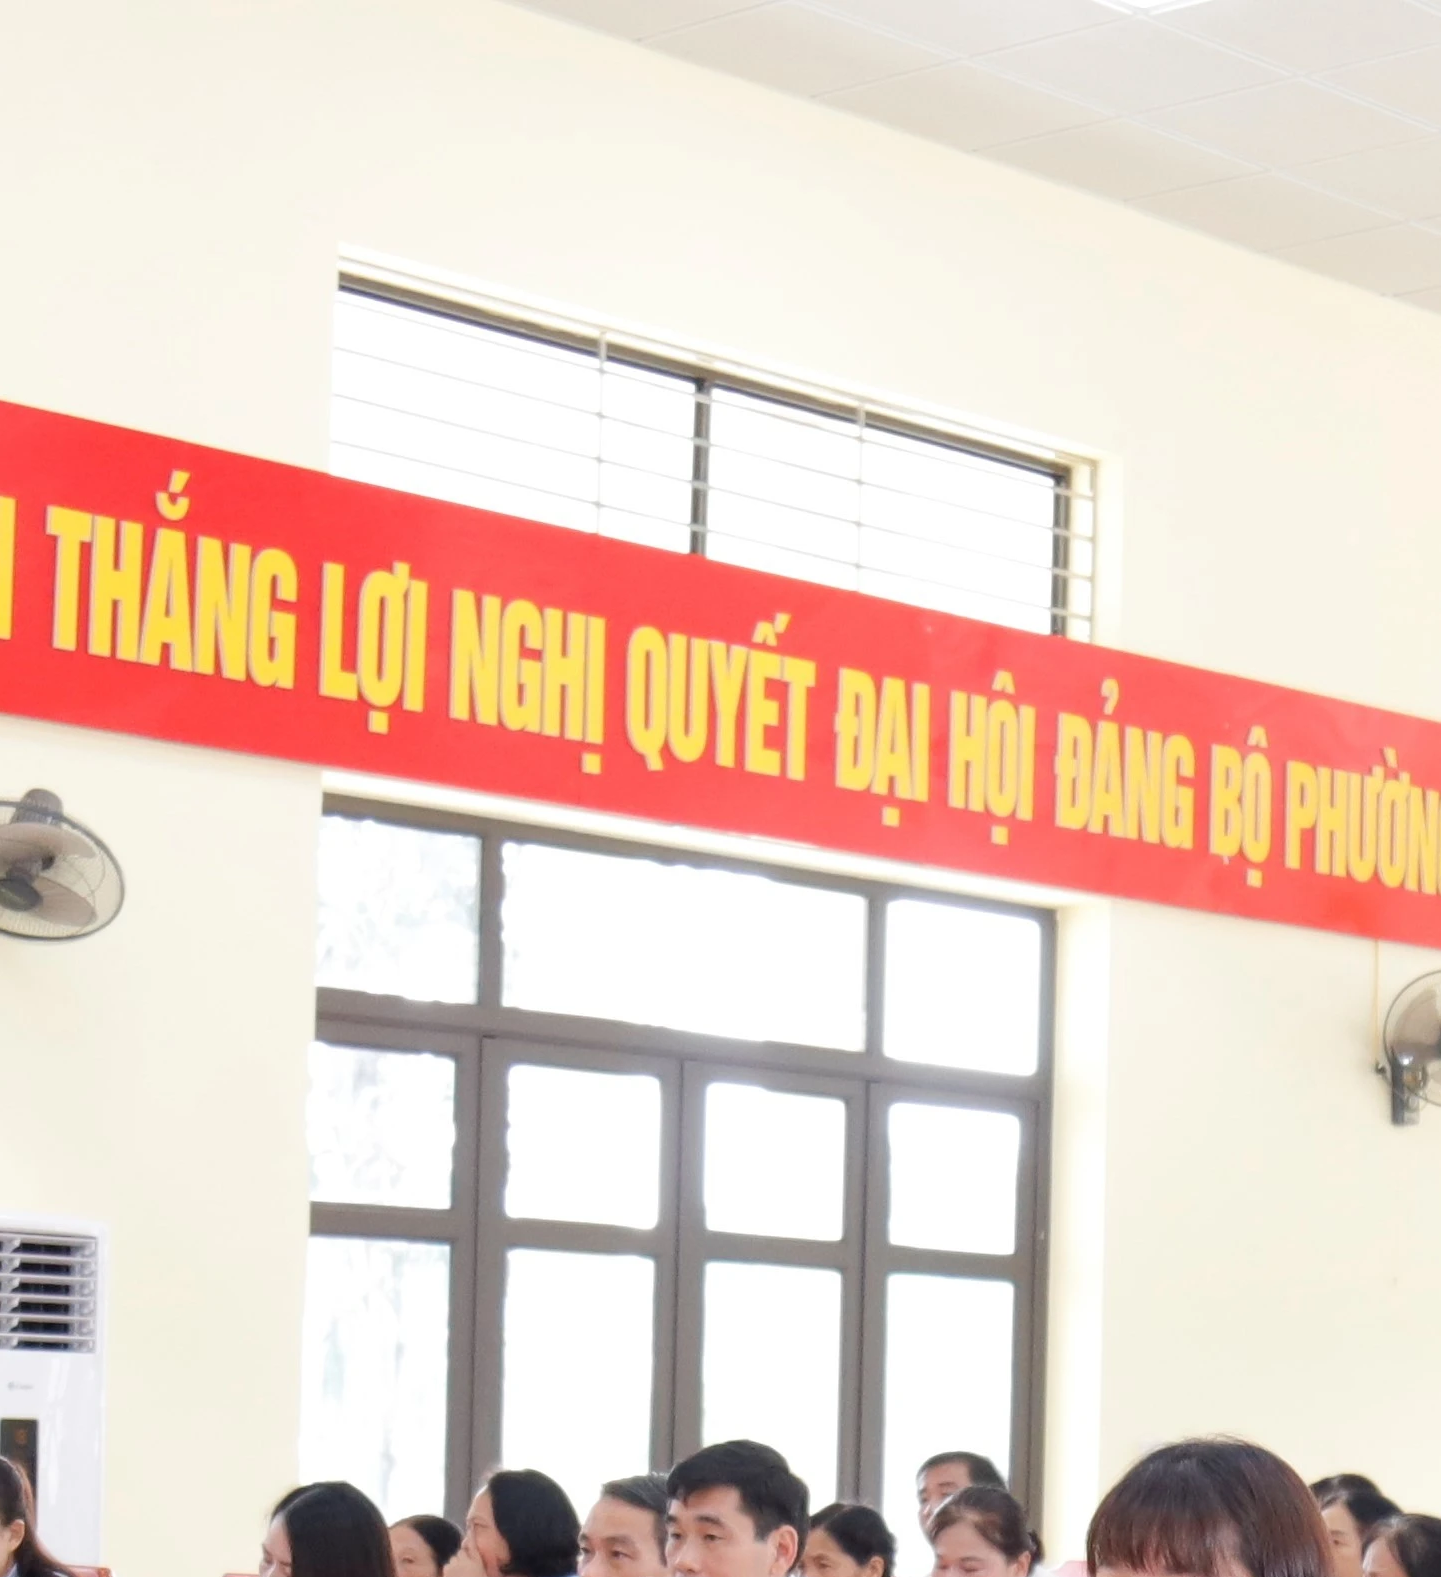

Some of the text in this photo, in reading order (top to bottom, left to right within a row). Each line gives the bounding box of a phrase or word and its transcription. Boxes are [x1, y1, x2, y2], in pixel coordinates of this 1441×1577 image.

[47, 470, 299, 690] THẮNG
[321, 561, 430, 734] LỢI
[451, 588, 607, 775] NGHỊ
[627, 612, 818, 782] QUYẾT
[835, 667, 932, 827] ĐẠI
[950, 670, 1037, 846] HỘI
[1055, 678, 1197, 850] ĐẢNG
[1210, 726, 1273, 888] BỘ
